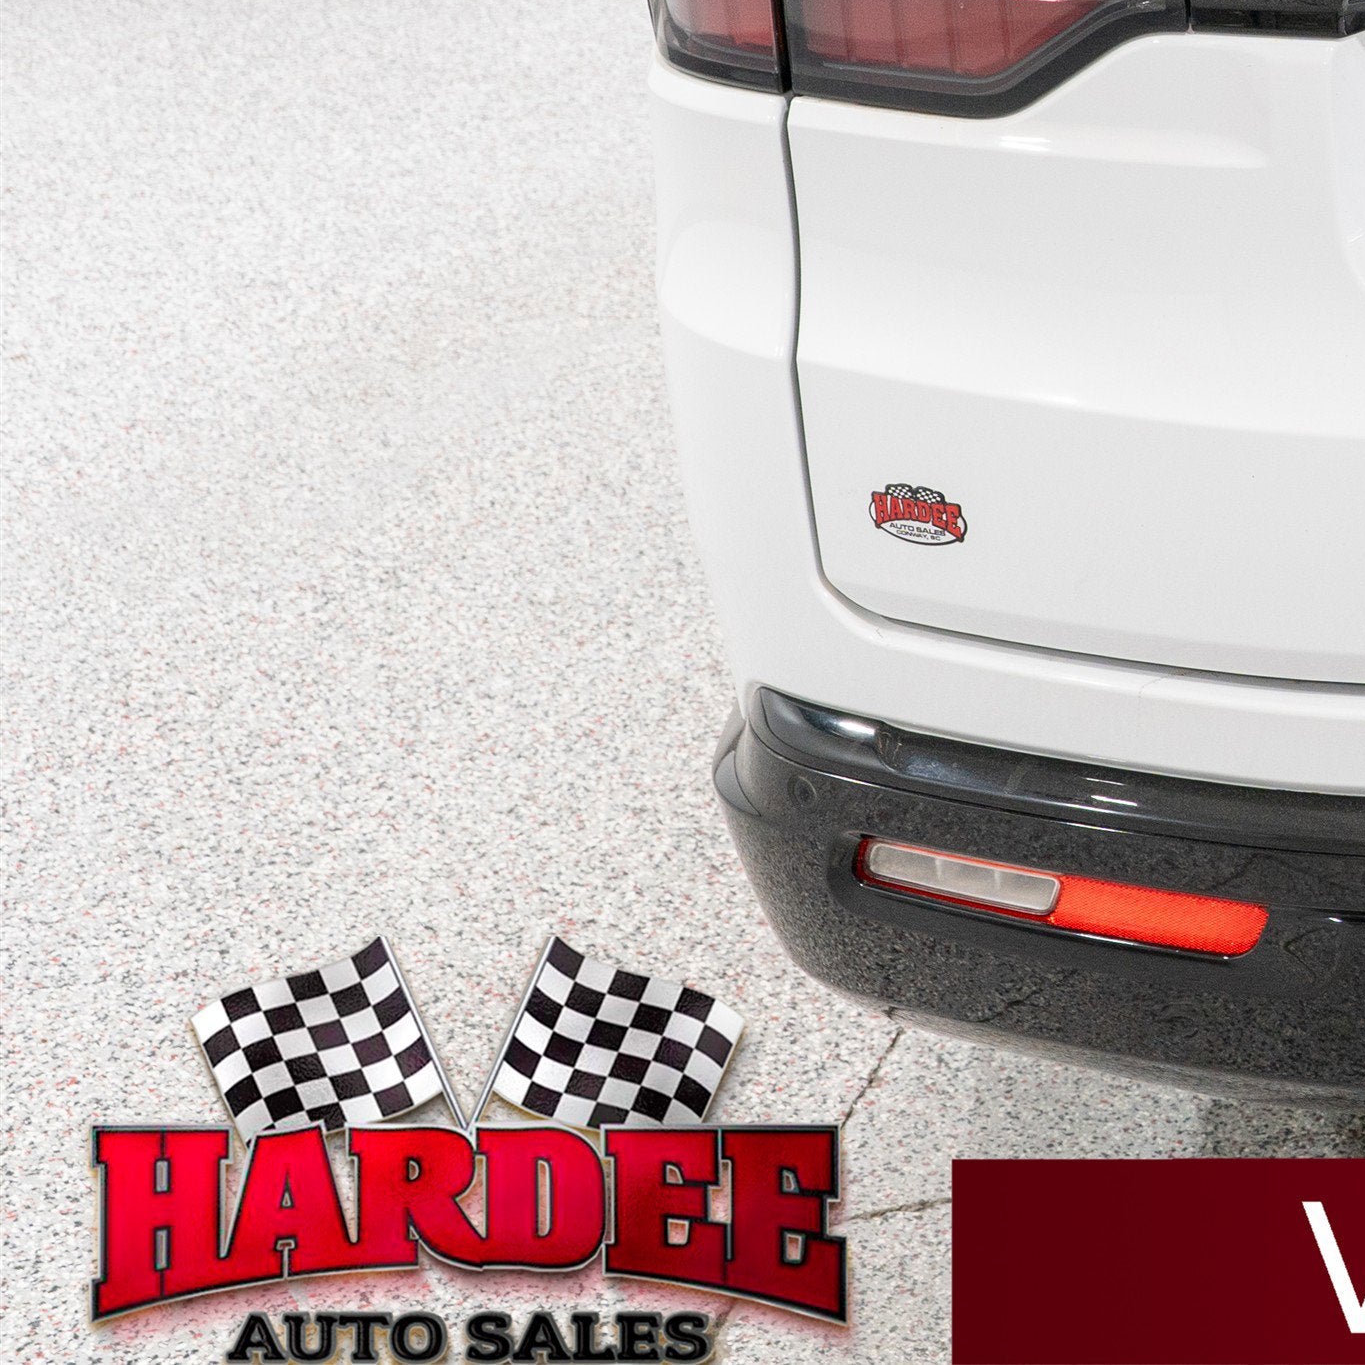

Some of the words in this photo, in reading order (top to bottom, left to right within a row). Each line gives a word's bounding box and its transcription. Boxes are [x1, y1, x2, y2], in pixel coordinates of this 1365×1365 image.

[871, 491, 963, 541] HARDEE
[889, 522, 915, 532] AUTO
[915, 526, 946, 537] SALES
